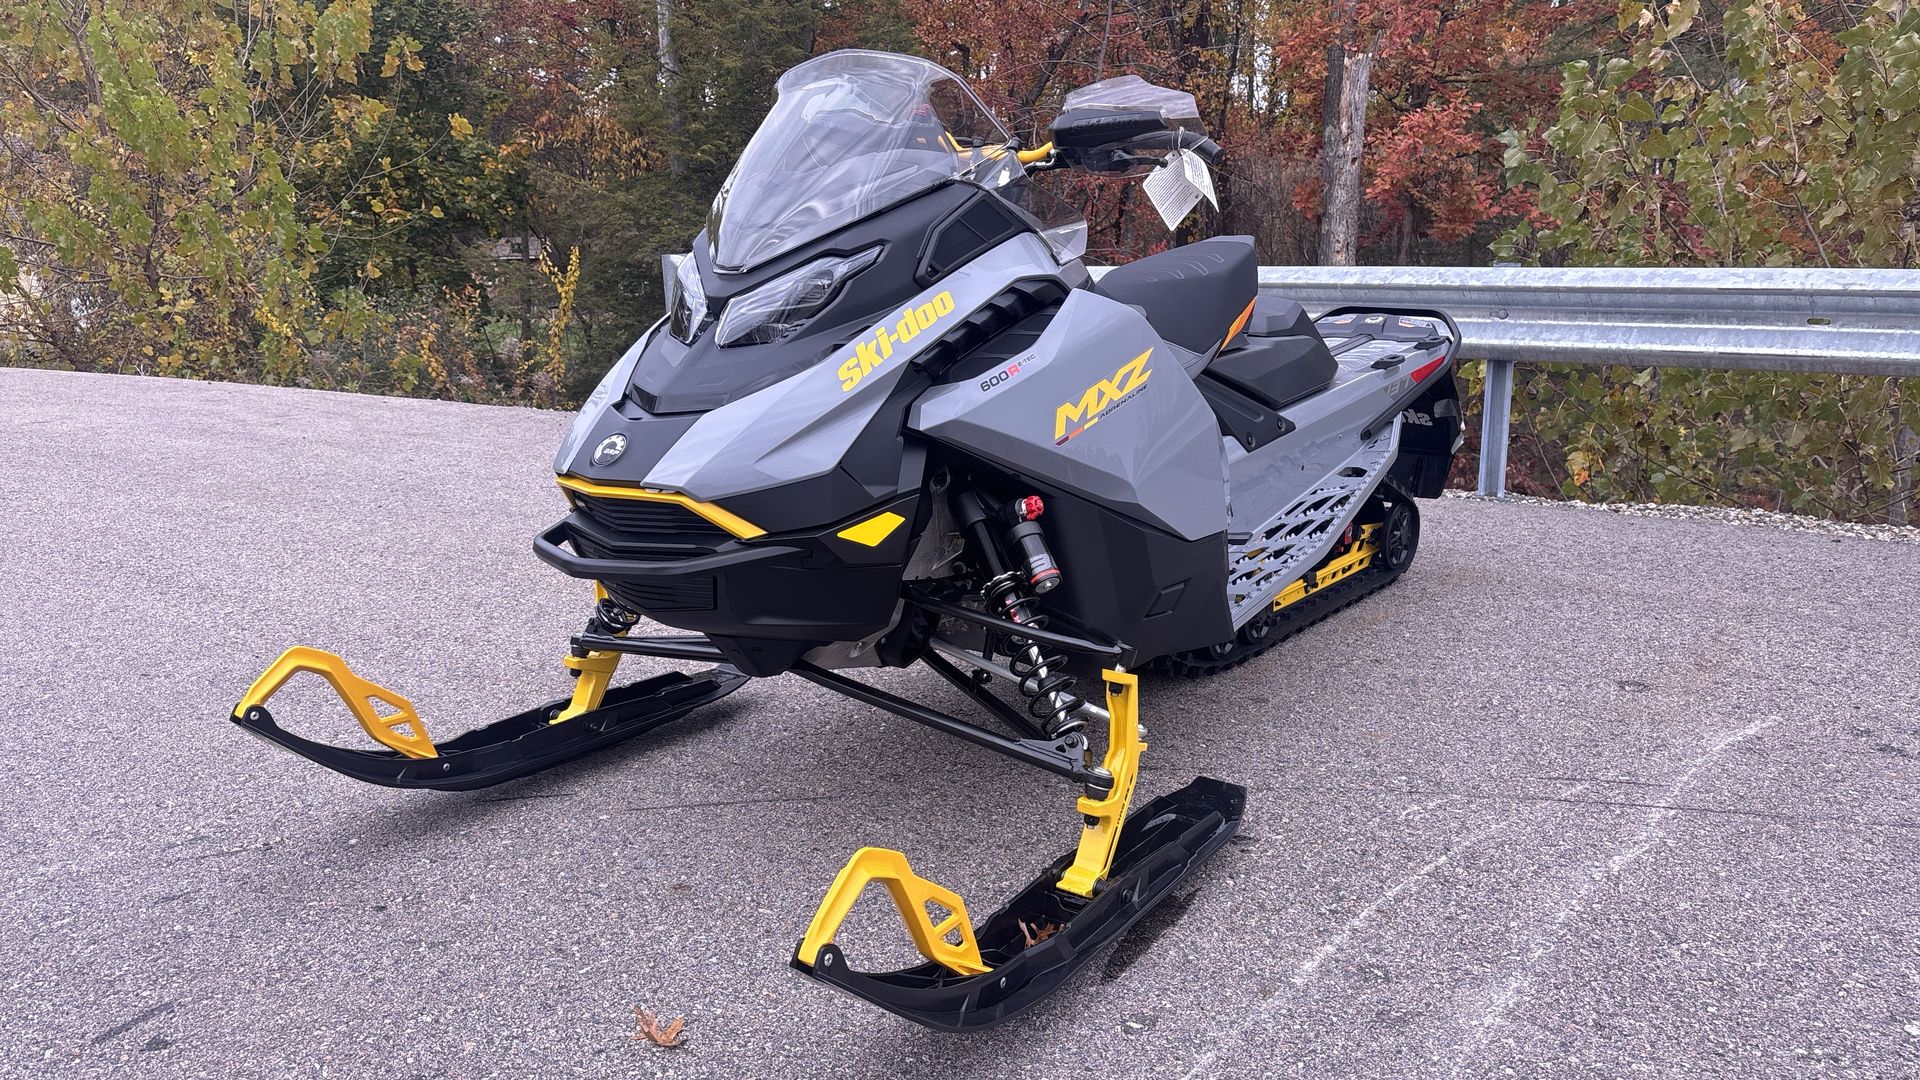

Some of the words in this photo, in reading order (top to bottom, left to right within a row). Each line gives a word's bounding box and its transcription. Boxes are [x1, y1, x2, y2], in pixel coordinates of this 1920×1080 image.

[837, 290, 955, 392] ski-doo
[1054, 347, 1154, 440] MXZ
[1099, 383, 1149, 420] ADRENALINE
